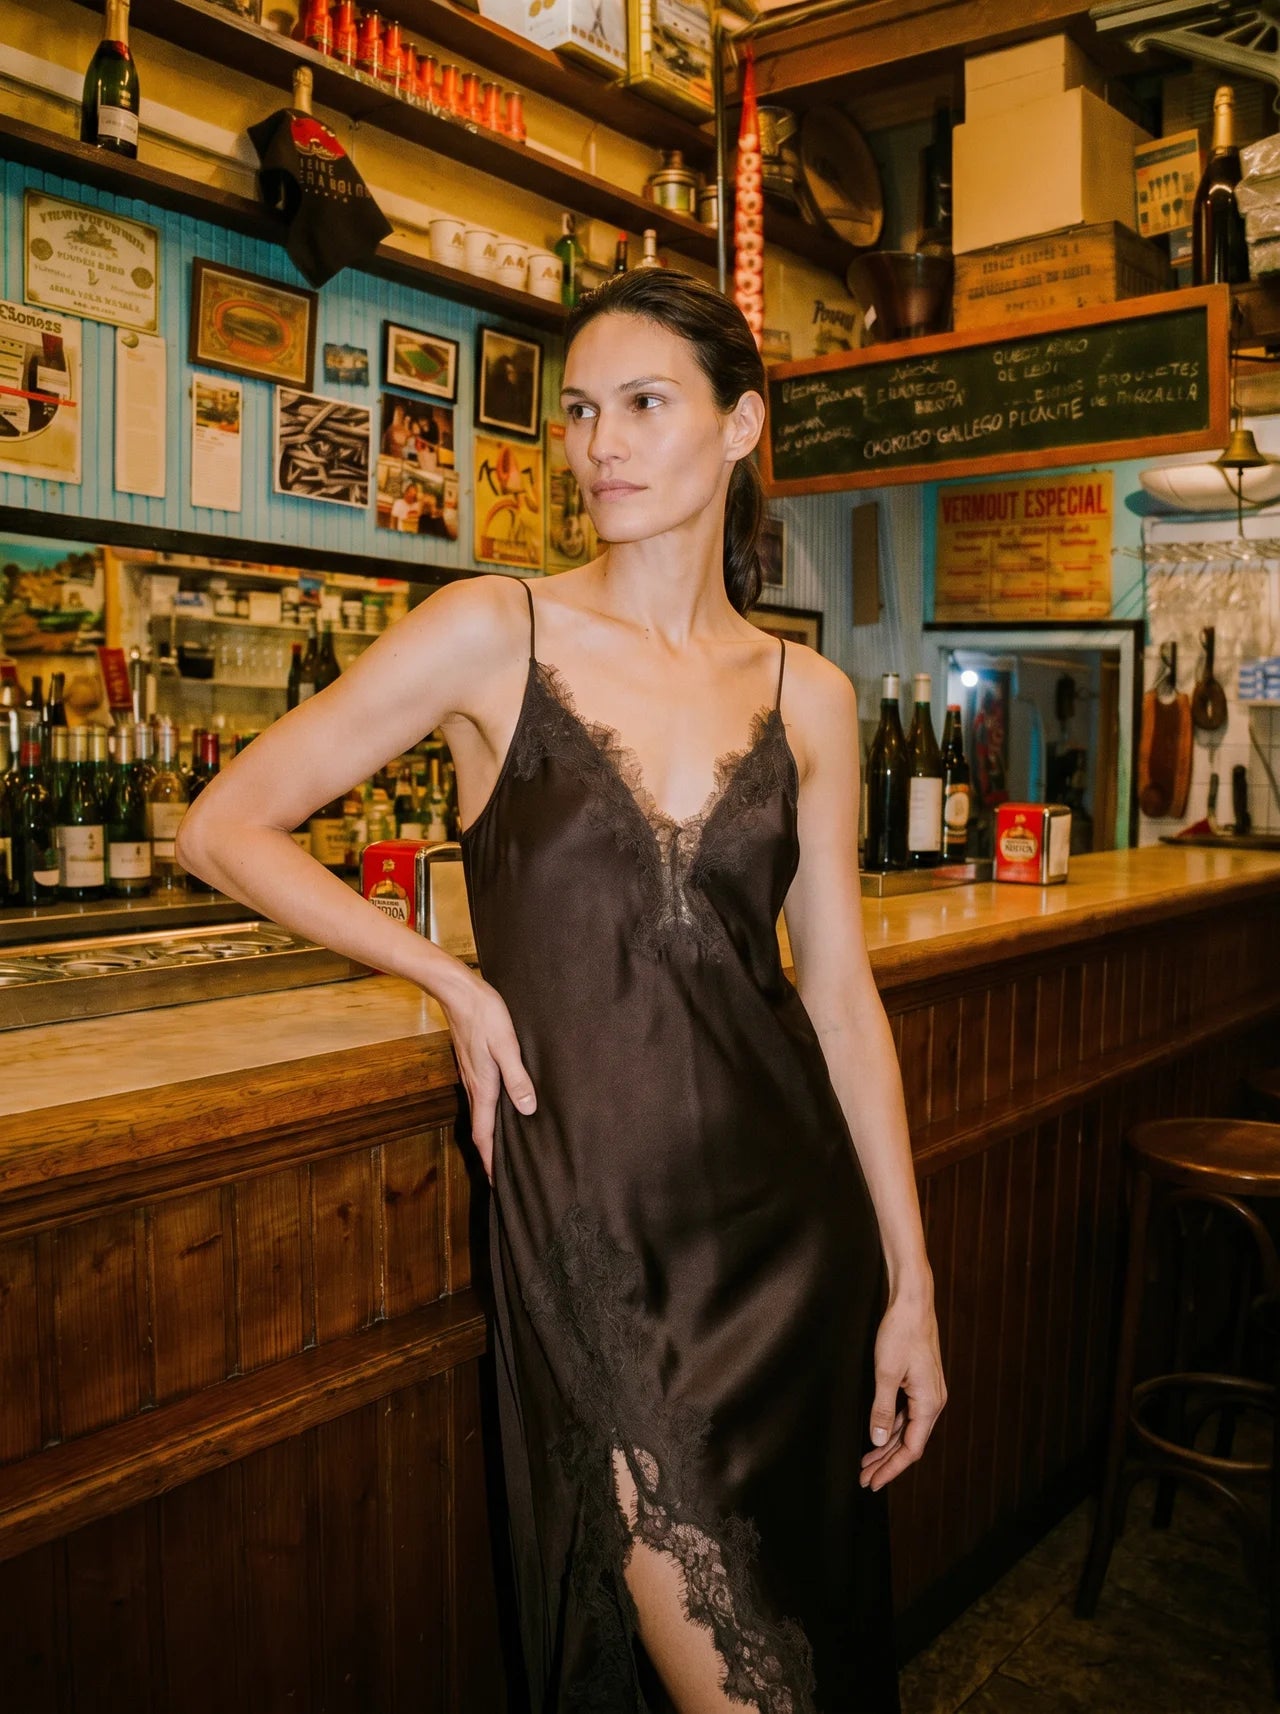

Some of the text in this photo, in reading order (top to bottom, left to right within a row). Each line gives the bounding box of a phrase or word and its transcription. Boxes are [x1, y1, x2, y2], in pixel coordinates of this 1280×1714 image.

[936, 412, 1003, 444] GALLEGO
[941, 483, 1108, 524] VERMOUT ESPECIAL
